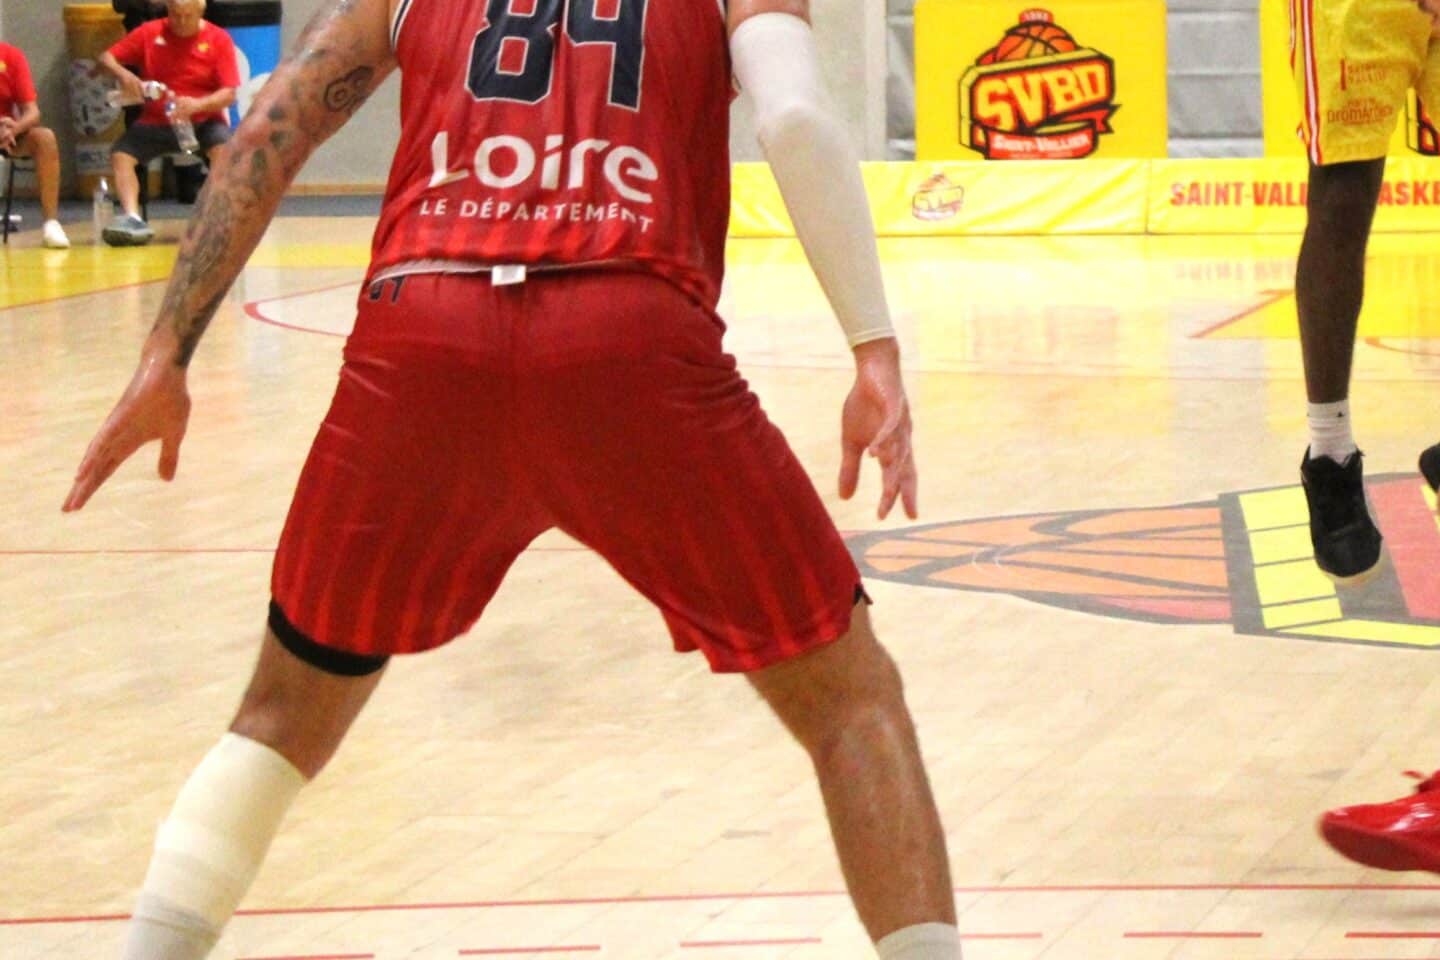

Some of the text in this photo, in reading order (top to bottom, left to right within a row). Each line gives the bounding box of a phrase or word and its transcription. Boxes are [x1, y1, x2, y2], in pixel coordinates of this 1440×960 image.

[975, 63, 1109, 132] SVBD
[428, 131, 659, 203] Loire
[420, 197, 654, 233] LE DÉPARTEMENT
